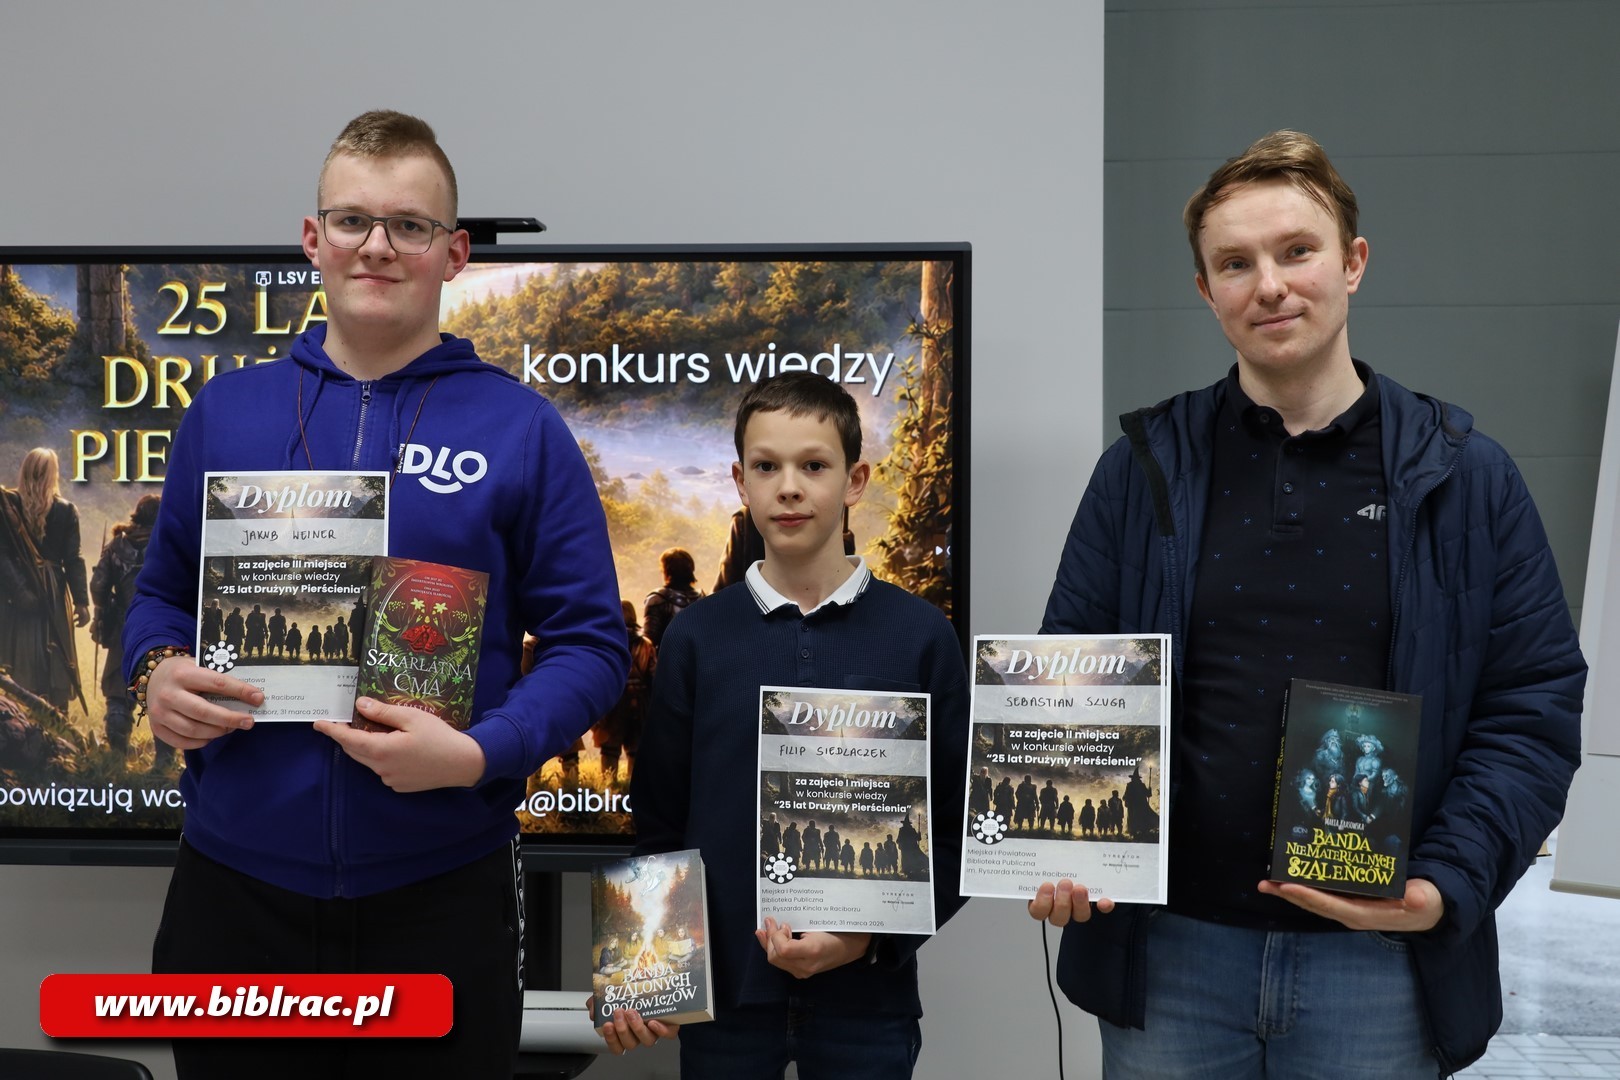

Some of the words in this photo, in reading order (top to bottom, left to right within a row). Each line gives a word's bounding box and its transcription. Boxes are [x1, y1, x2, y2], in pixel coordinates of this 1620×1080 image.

[278, 271, 307, 284] LSV
[311, 271, 323, 284] E
[157, 281, 228, 335] 25
[522, 343, 710, 384] konkurs
[725, 342, 895, 397] wiedzy
[234, 482, 353, 514] Dyplom
[237, 561, 251, 569] za
[252, 559, 291, 572] zajęcie
[292, 560, 301, 568] III
[303, 559, 347, 571] miejsca
[252, 572, 302, 581] konkursie
[304, 571, 341, 583] wiedzy
[237, 585, 252, 594] lat
[254, 584, 299, 596] Drużyny
[367, 648, 473, 681] SZKARŁATNA
[1004, 647, 1126, 681] Dyplom
[393, 669, 442, 697] ĆMA
[1004, 696, 1074, 708] SEBASTIAN
[788, 701, 897, 732] Dyplom
[1009, 729, 1023, 738] za
[1024, 728, 1064, 741] zajęcie
[1065, 729, 1073, 739] II
[1074, 730, 1120, 742] miejsca
[779, 744, 806, 756] FILIP
[1011, 743, 1021, 751] w
[1023, 741, 1075, 752] konkursie
[1076, 743, 1115, 755] wiedzy
[1007, 754, 1023, 764] lat
[1024, 754, 1072, 767] Drużyny
[795, 778, 807, 786] za
[808, 777, 844, 789] zajęcie
[850, 779, 890, 790] miejsca
[141, 788, 187, 808] wc
[806, 789, 852, 799] konkursie
[854, 791, 888, 802] wiedzy
[793, 801, 807, 810] lat
[808, 802, 850, 813] Drużyny
[1311, 827, 1372, 852] BANDA
[1286, 841, 1397, 871] NIEMATERIALNYCH
[623, 961, 676, 984] BANDA
[604, 971, 692, 1003] SZALONYCH
